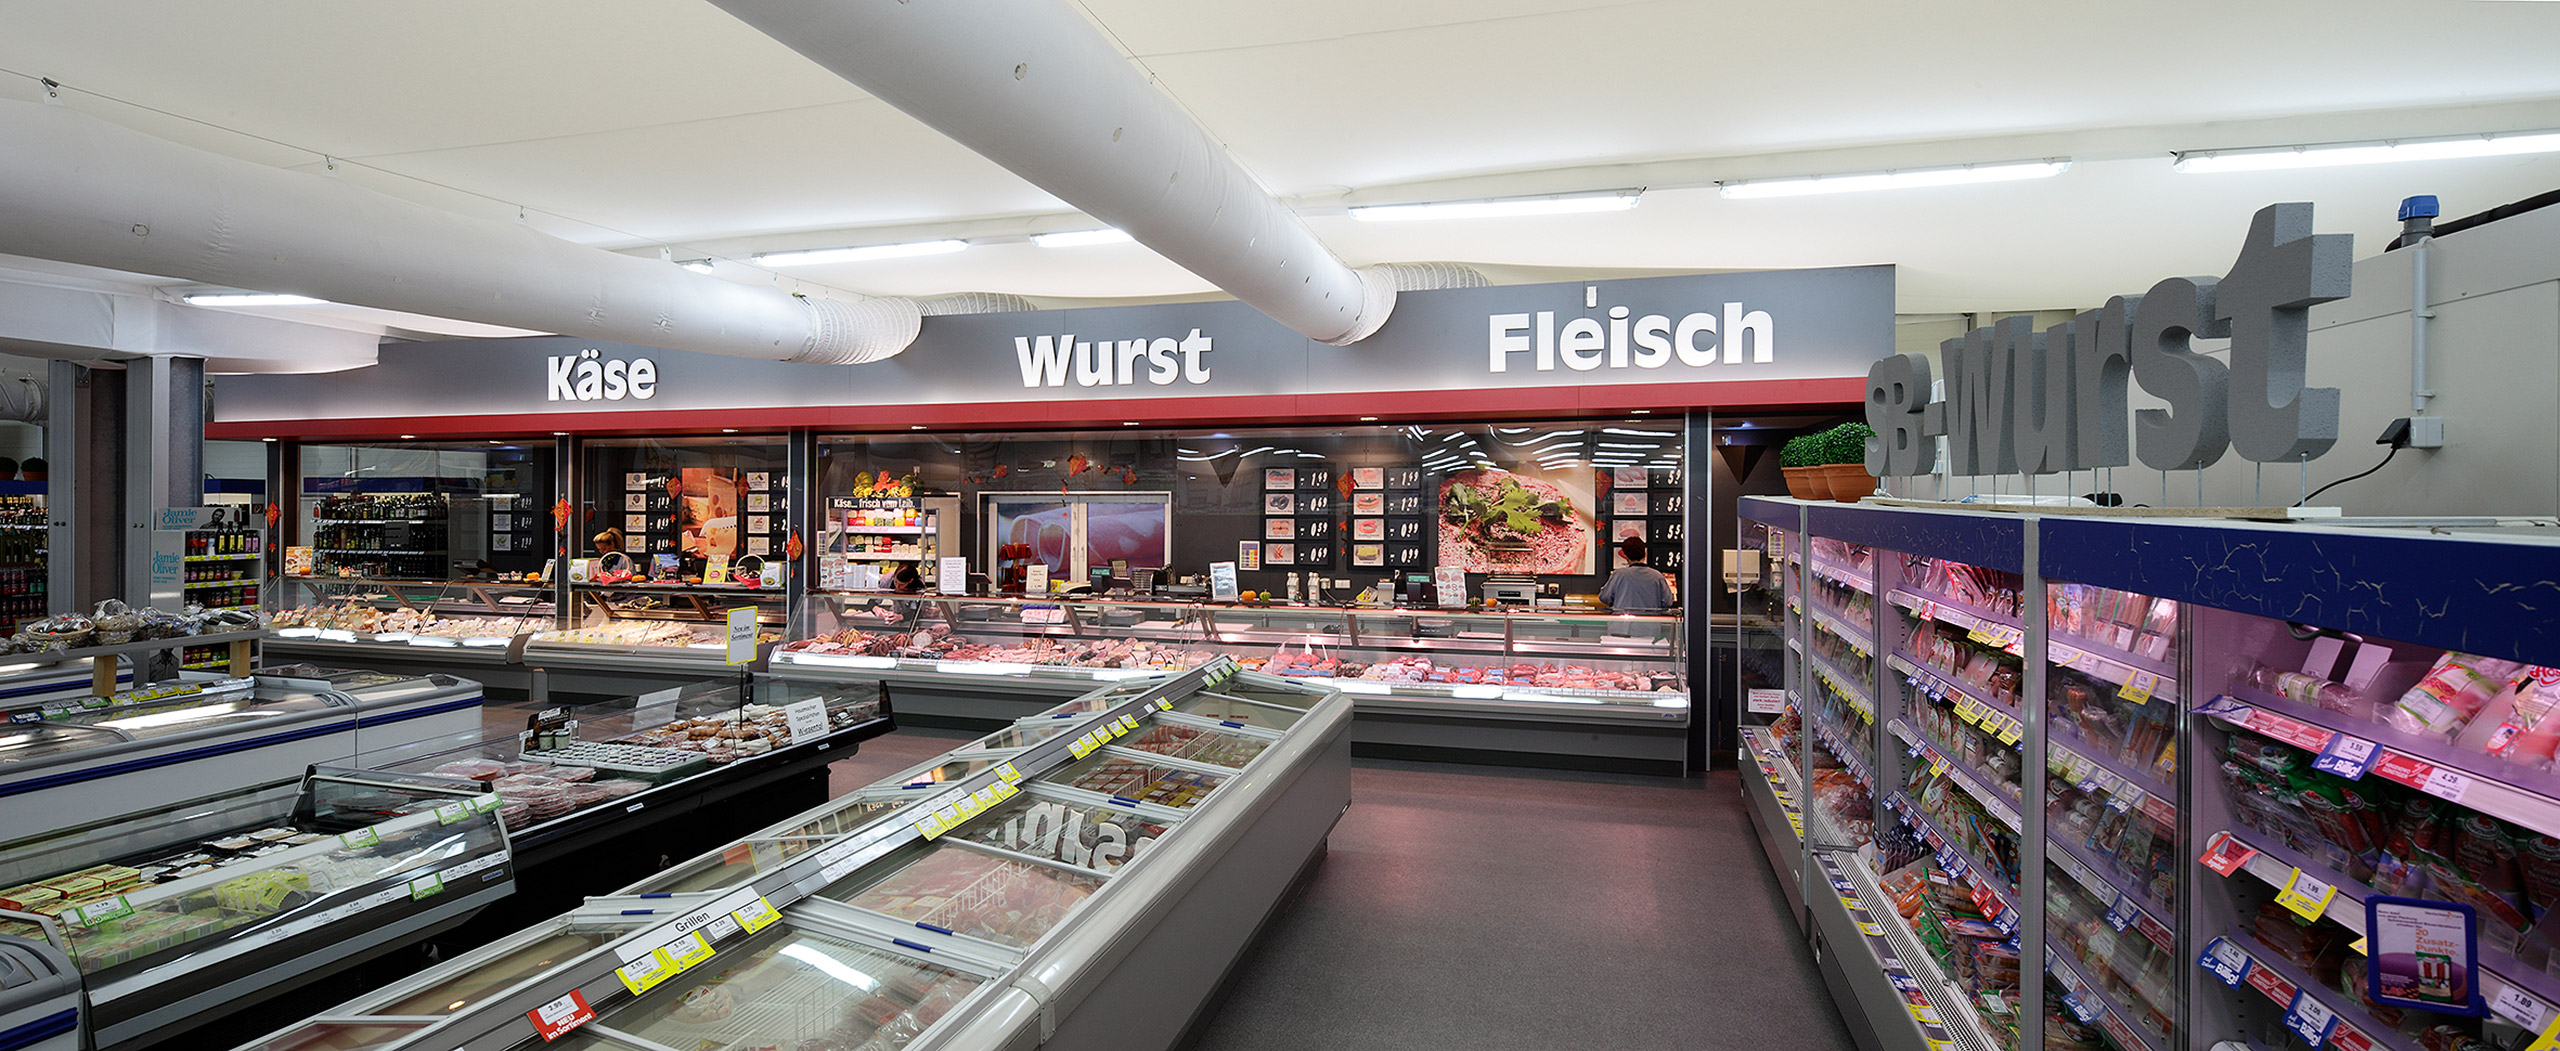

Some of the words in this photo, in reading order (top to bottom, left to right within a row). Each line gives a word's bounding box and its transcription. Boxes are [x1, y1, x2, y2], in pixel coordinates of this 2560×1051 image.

[1489, 301, 1774, 373] Fleisch
[1014, 328, 1213, 388] Wurst
[548, 349, 656, 402] Käse
[859, 498, 881, 508] frisch
[882, 500, 898, 508] vom
[162, 507, 198, 519] Jamie
[162, 516, 195, 524] Oliver
[153, 551, 180, 563] Jamie
[152, 561, 179, 574] Oliver
[730, 632, 754, 641] Sortiment
[2333, 759, 2363, 778] Billig!
[85, 916, 102, 926] BIO
[674, 910, 711, 933] Grillen
[2415, 927, 2429, 937] 20
[2415, 936, 2460, 948] Zusatz-
[2415, 944, 2460, 957] Punkte.
[2214, 962, 2240, 986] Billig!
[2513, 993, 2533, 1008] 1.89
[545, 1026, 559, 1040] im
[556, 1012, 593, 1035] Sortiment
[556, 1013, 576, 1027] NEU
[2299, 1021, 2322, 1047] Billig!
